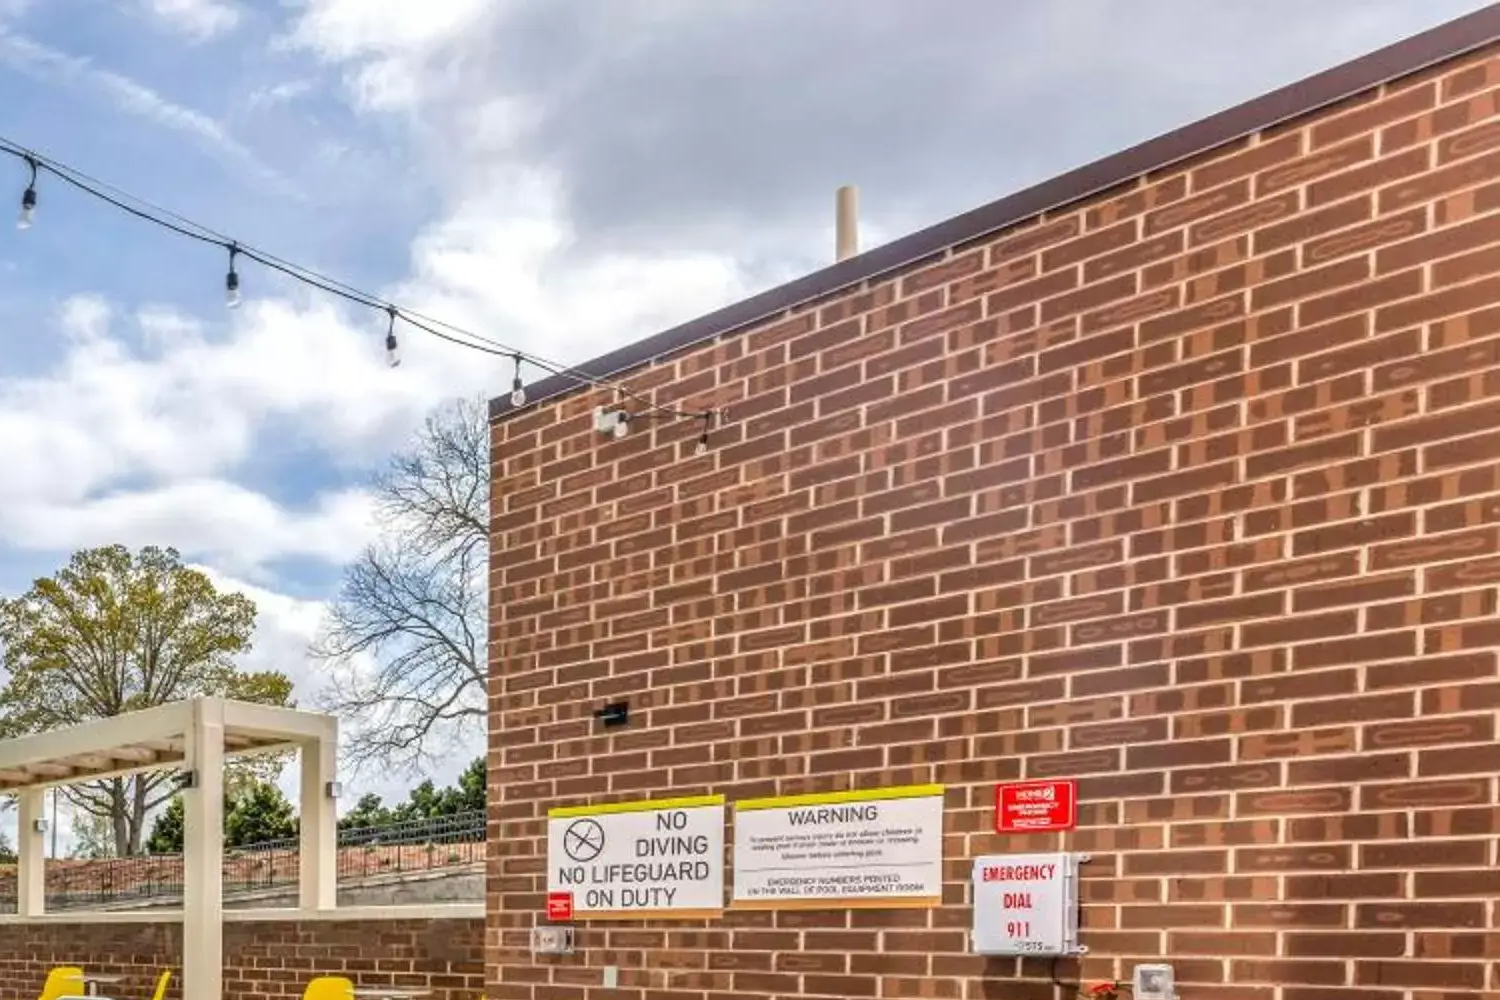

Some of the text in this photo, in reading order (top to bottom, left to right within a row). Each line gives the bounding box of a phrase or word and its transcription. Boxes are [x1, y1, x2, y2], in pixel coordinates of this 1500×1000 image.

[656, 811, 687, 830] NO
[787, 805, 878, 826] WARNING
[635, 835, 709, 857] DIVING
[559, 861, 709, 885] NO LIFEGUARD
[983, 864, 1056, 882] EMERGENCY
[586, 889, 614, 908] ON
[621, 887, 677, 907] DUTY
[1003, 893, 1033, 909] DIAL
[1007, 921, 1031, 939] 911
